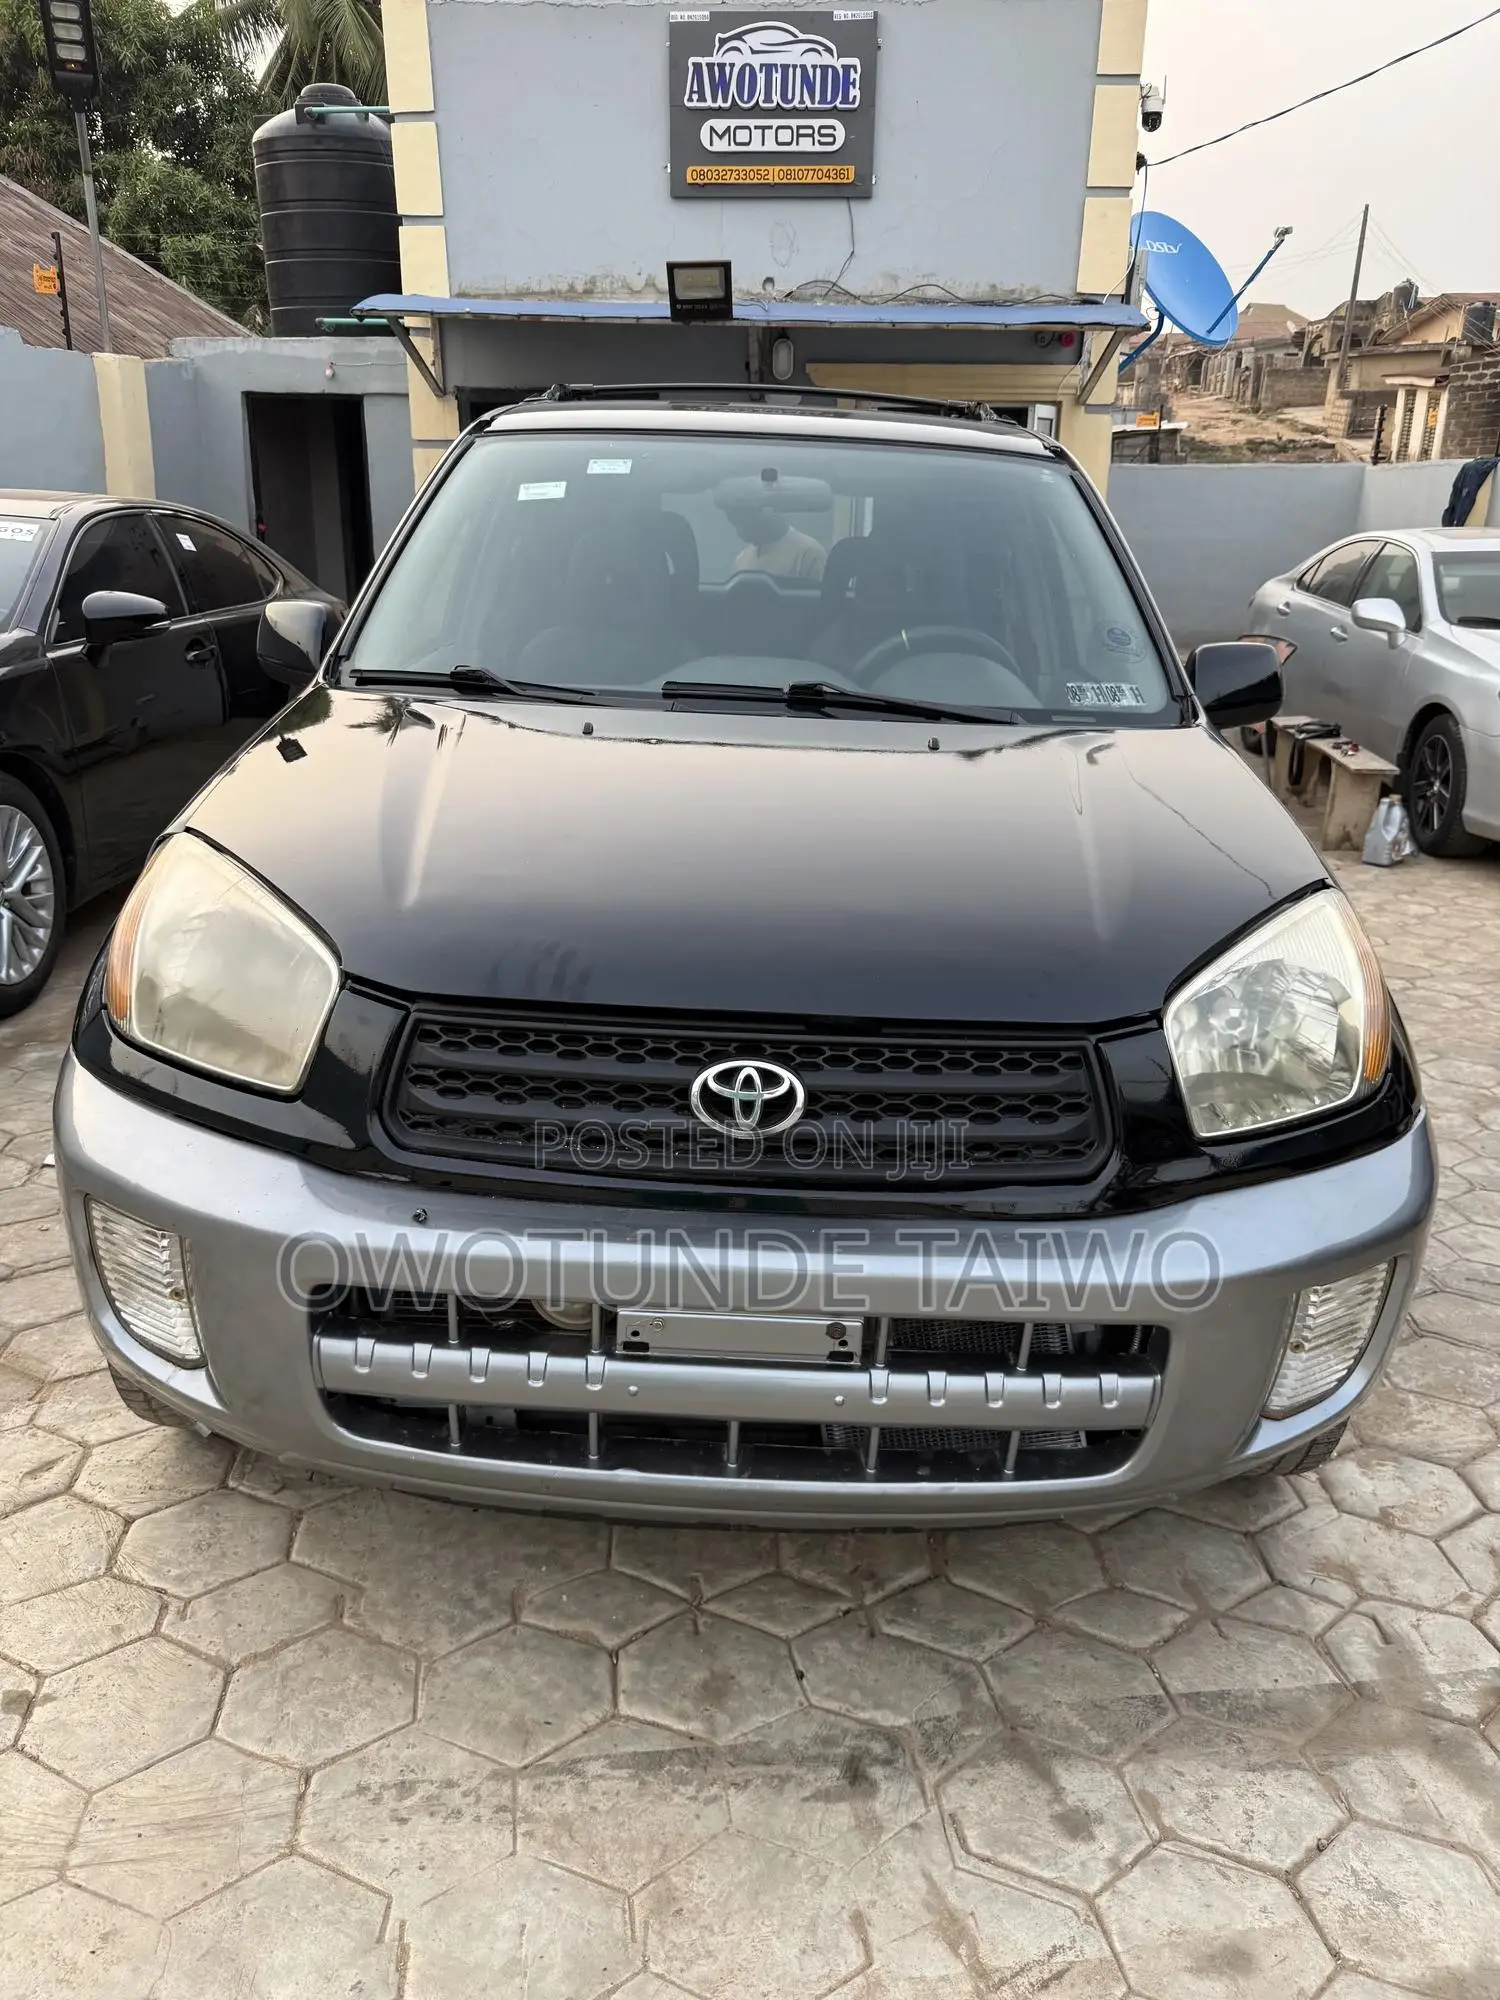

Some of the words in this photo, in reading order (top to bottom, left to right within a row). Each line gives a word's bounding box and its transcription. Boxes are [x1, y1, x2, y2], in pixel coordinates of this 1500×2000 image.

[685, 60, 859, 107] AWOTUNDE
[709, 125, 837, 147] MOTORS
[690, 168, 770, 181] 08032733052
